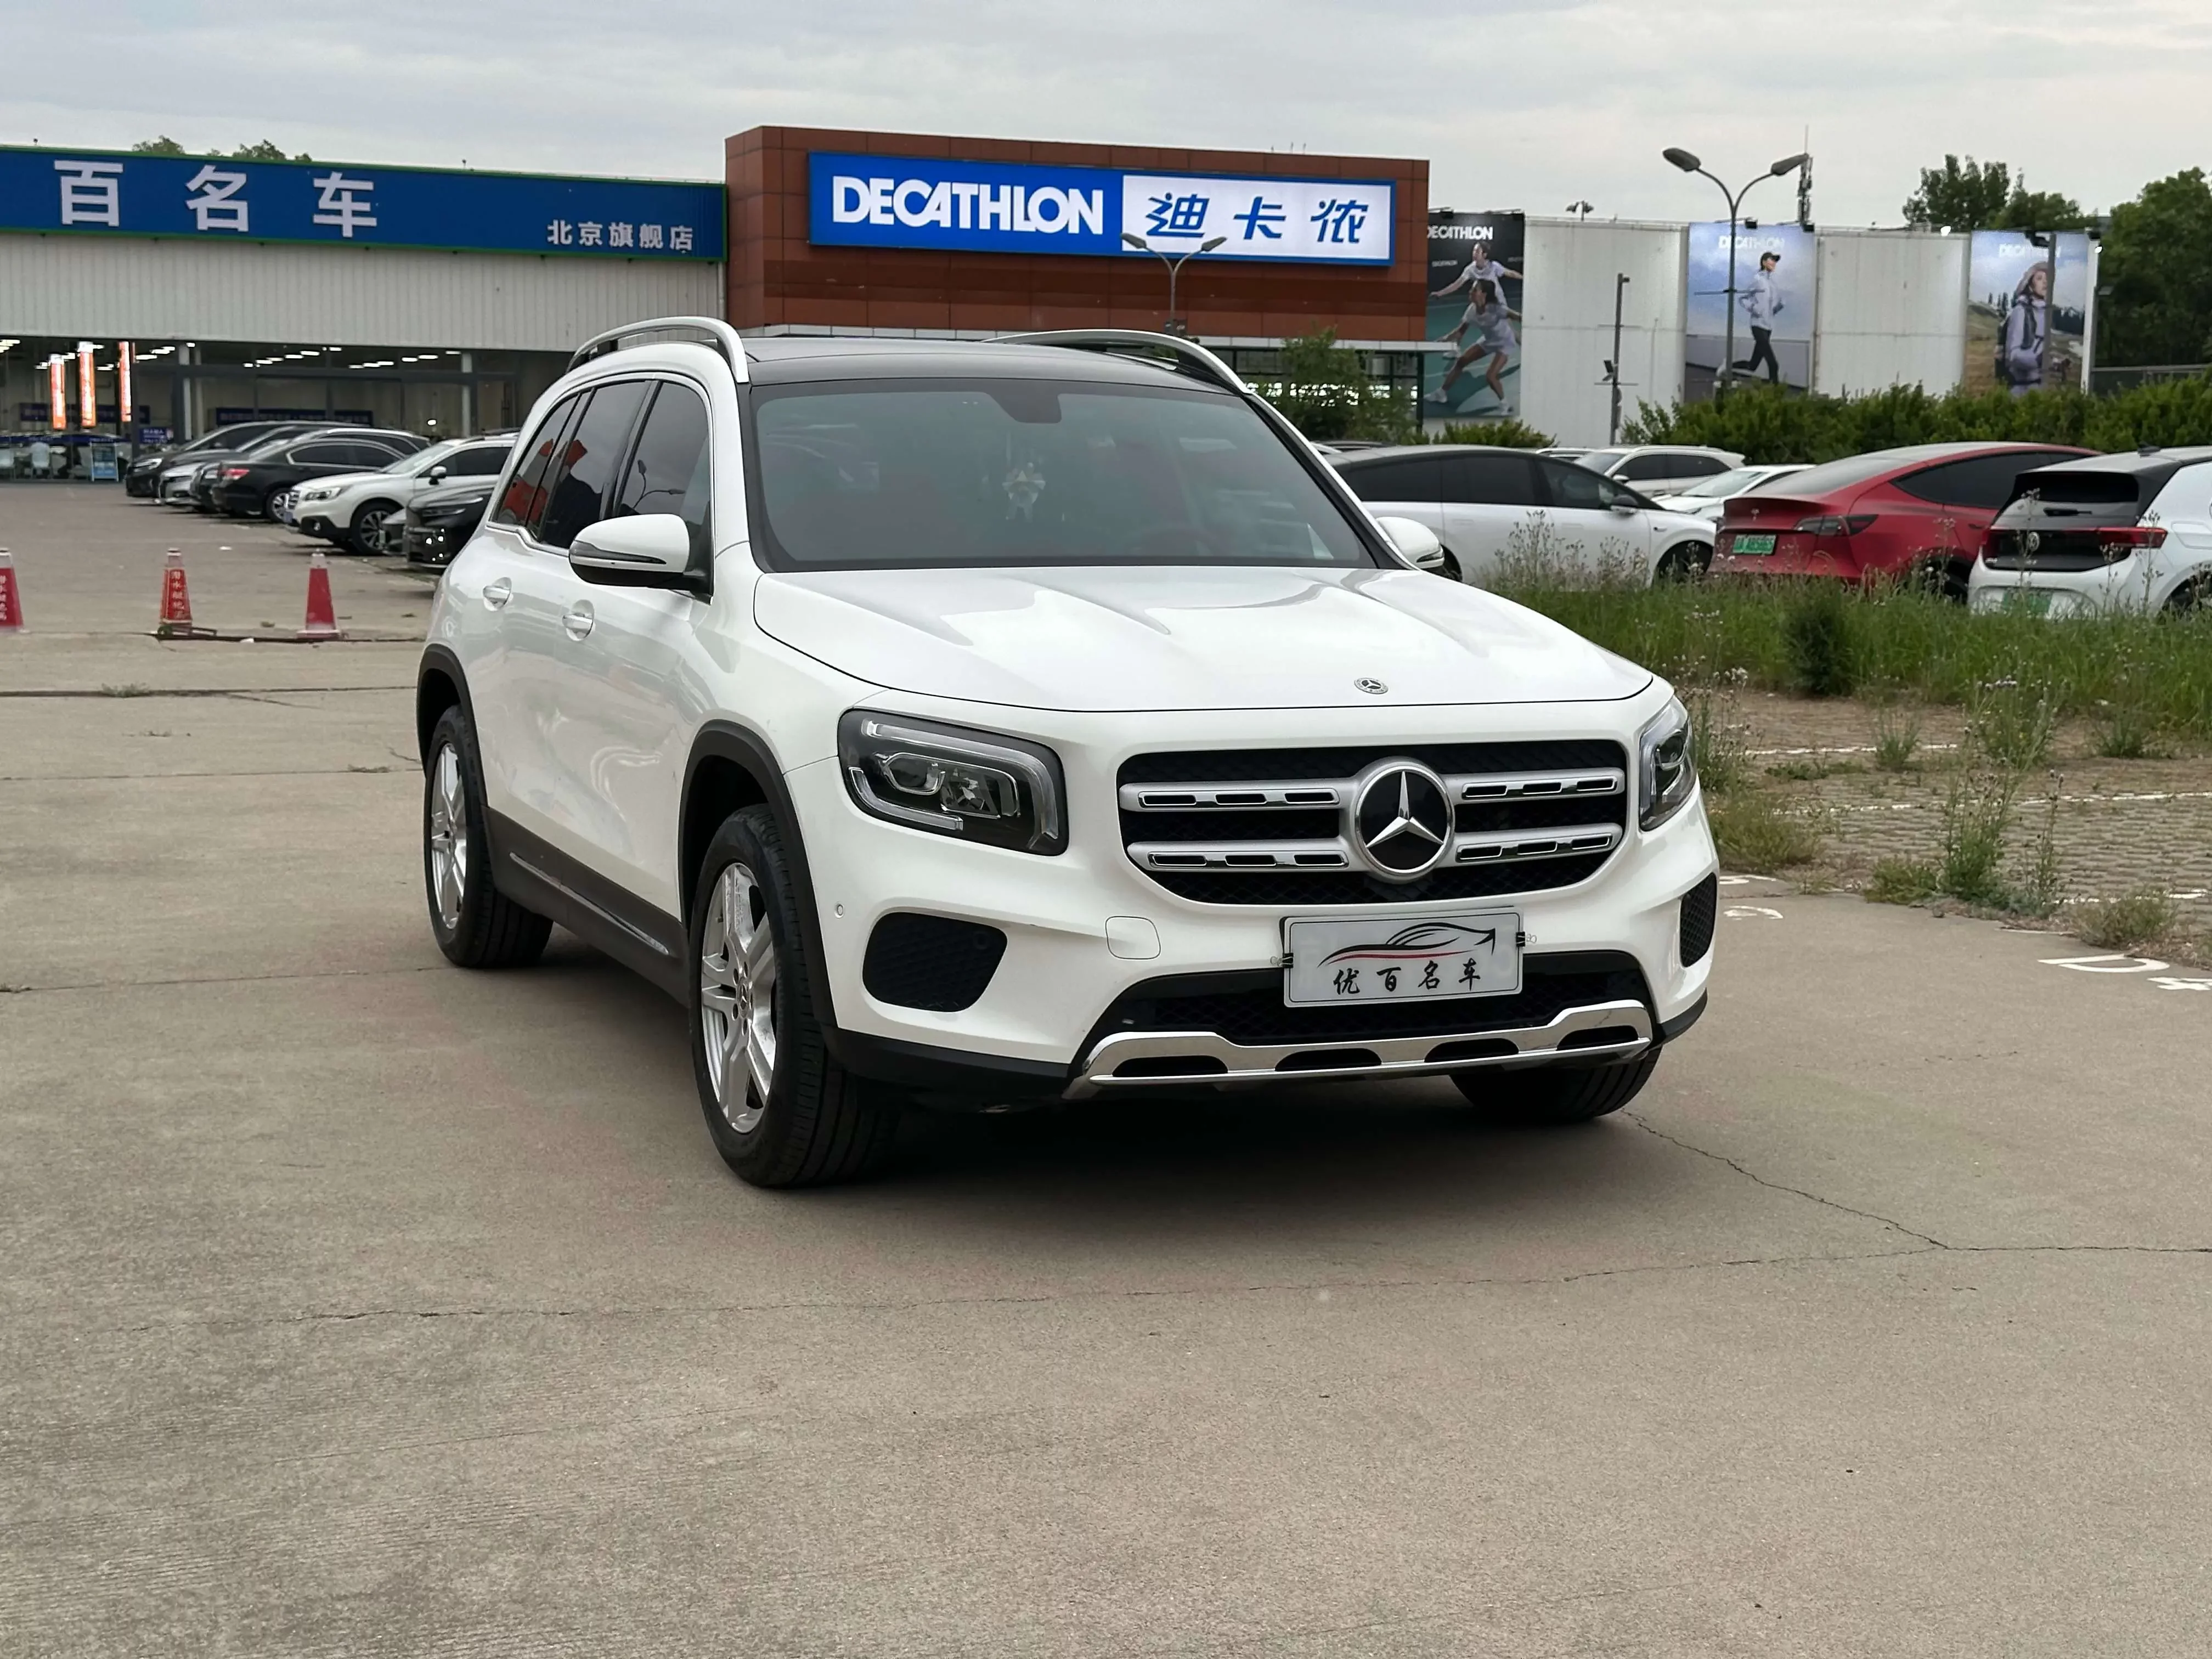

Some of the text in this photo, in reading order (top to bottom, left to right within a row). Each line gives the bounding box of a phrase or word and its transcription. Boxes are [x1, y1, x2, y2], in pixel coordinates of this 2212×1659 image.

[54, 160, 377, 238] 百名车
[833, 176, 1103, 235] DECATHLON
[1146, 192, 1368, 243] 迪卡侬
[547, 219, 693, 251] 北京旗舰店
[1333, 958, 1480, 995] 优百名车
